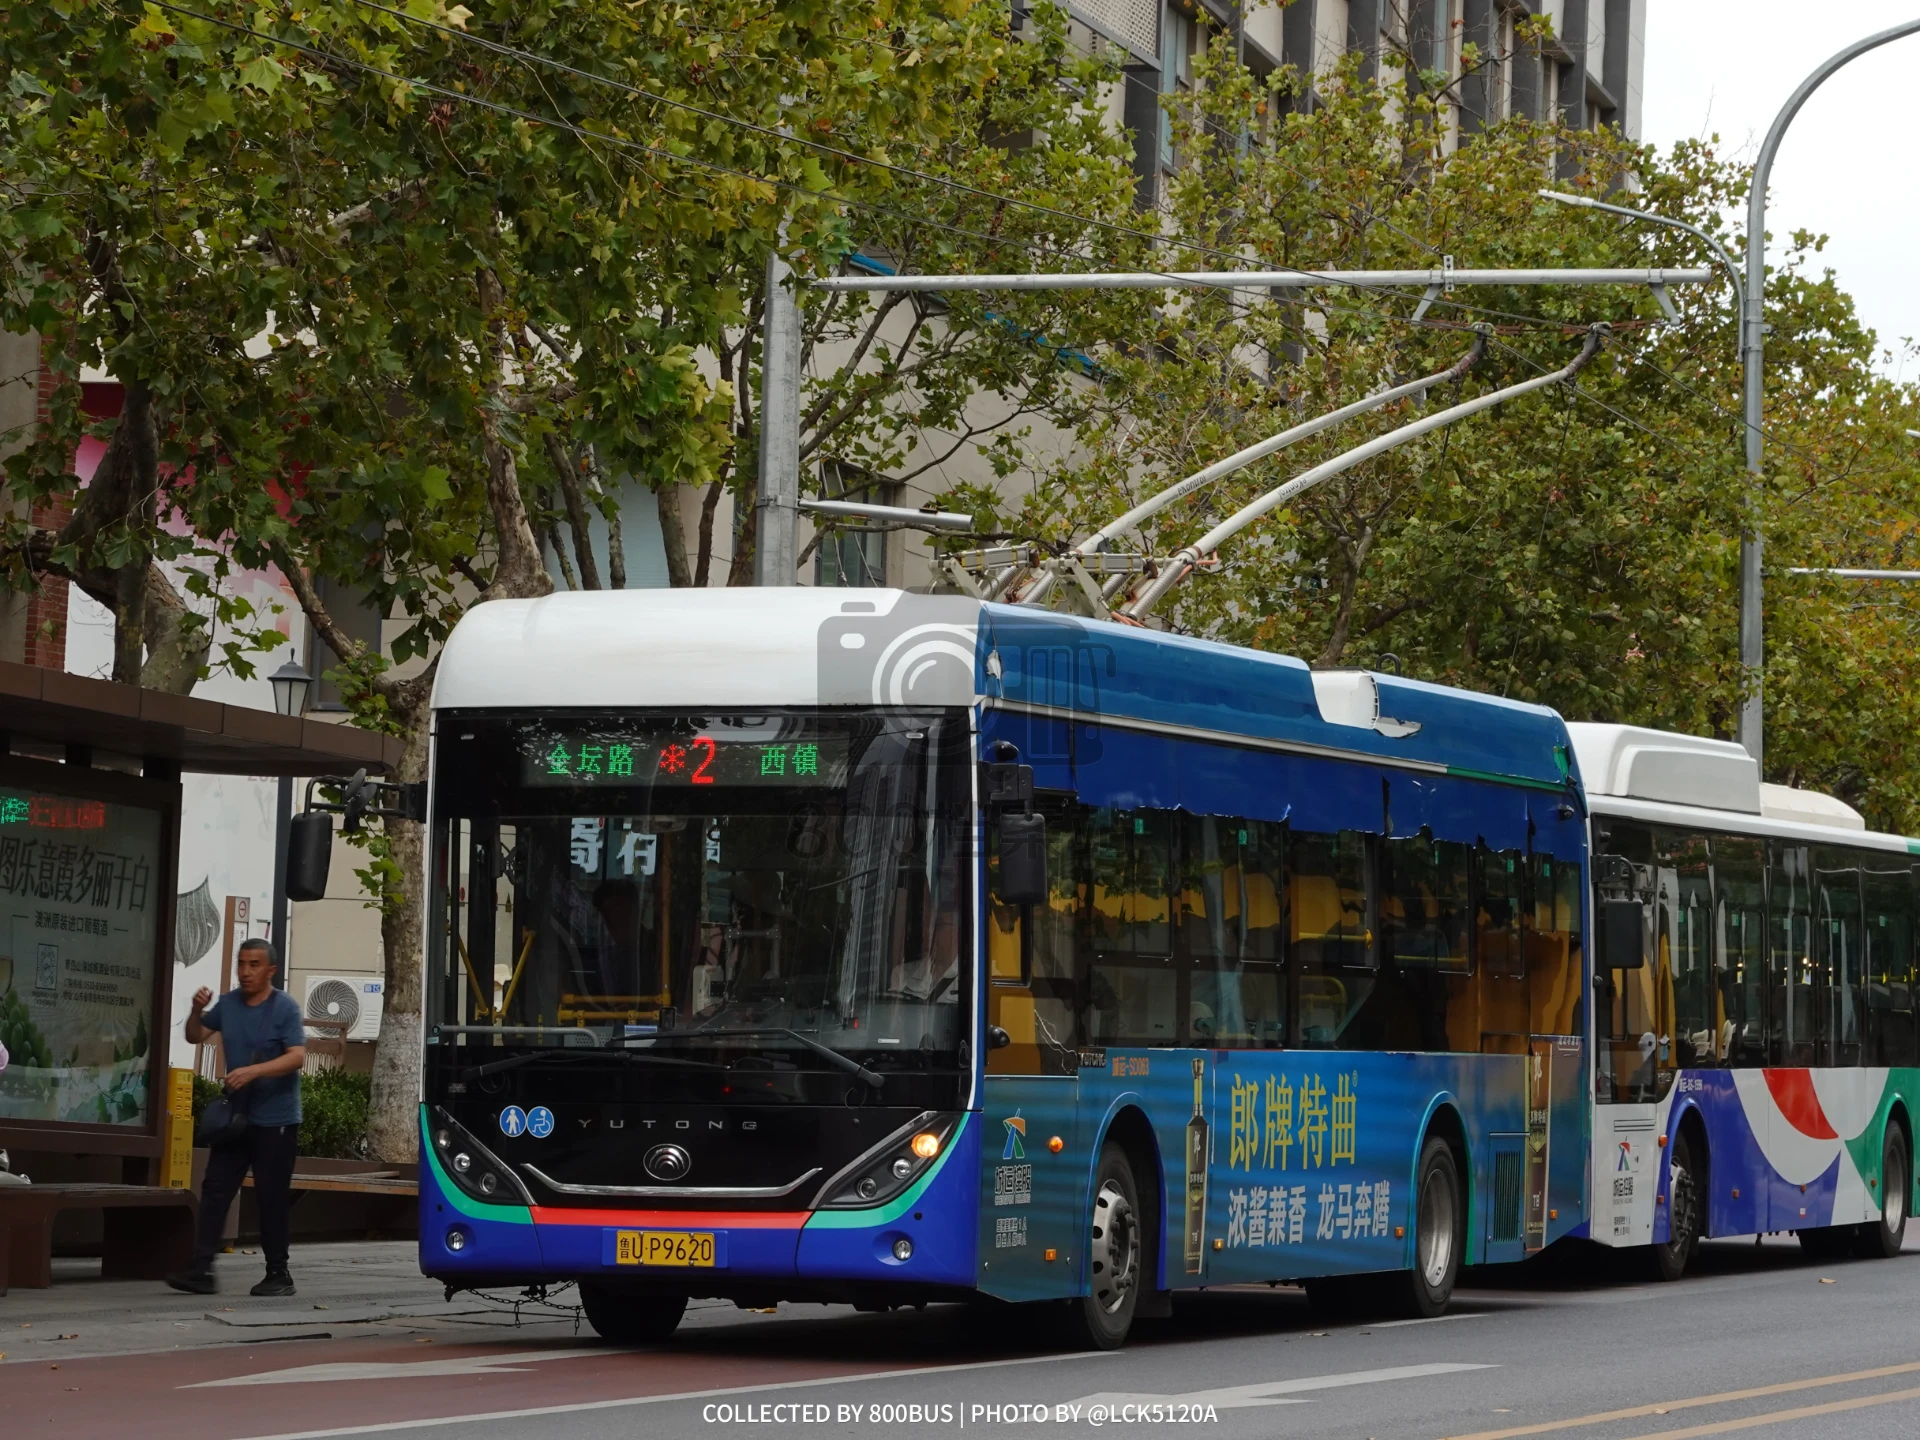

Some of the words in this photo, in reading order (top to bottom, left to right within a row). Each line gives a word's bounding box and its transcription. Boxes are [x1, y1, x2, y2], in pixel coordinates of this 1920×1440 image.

[547, 743, 634, 775] 金坛路
[760, 743, 818, 775] 西镇
[35, 910, 108, 936] 澳洲原装进口葡萄酒
[577, 1118, 758, 1131] YUTONG
[1229, 1073, 1357, 1172] 郎牌特曲
[995, 1164, 1032, 1194] 城运控股
[1227, 1185, 1307, 1248] 浓酱兼香
[1316, 1179, 1391, 1241] 龙马奔腾
